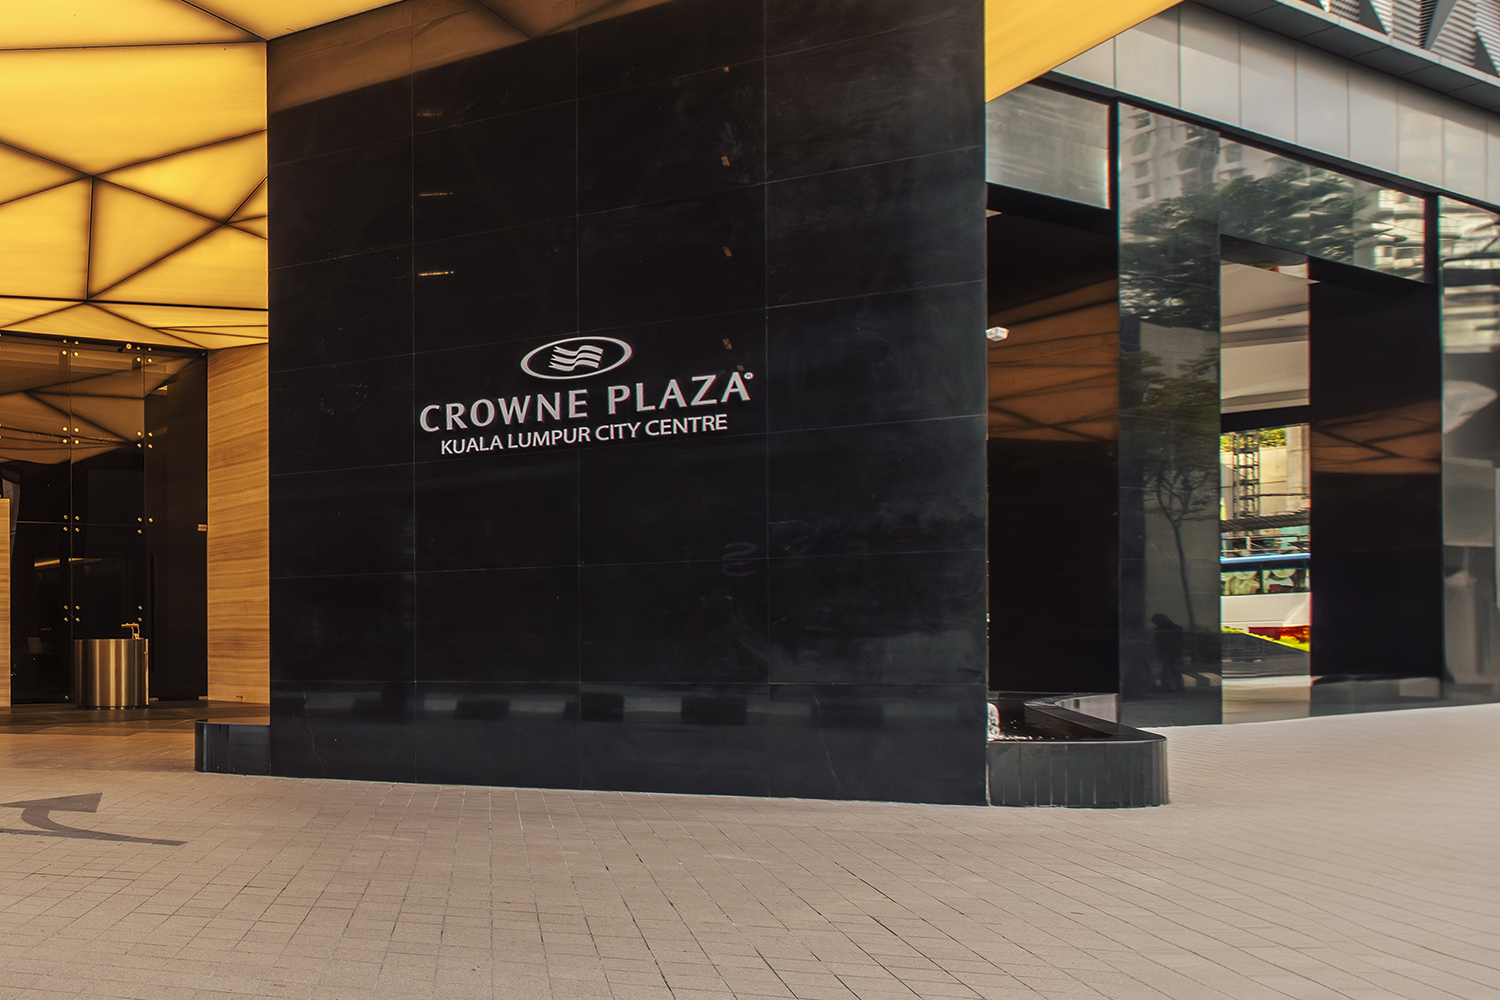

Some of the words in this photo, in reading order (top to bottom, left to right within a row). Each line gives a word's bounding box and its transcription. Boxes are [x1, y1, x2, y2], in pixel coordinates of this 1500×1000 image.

[419, 388, 588, 432] CROWNE
[441, 434, 504, 455] KUALA
[507, 427, 591, 449] LUMPUR
[595, 421, 642, 441] CITY
[645, 413, 728, 436] CENTRE
